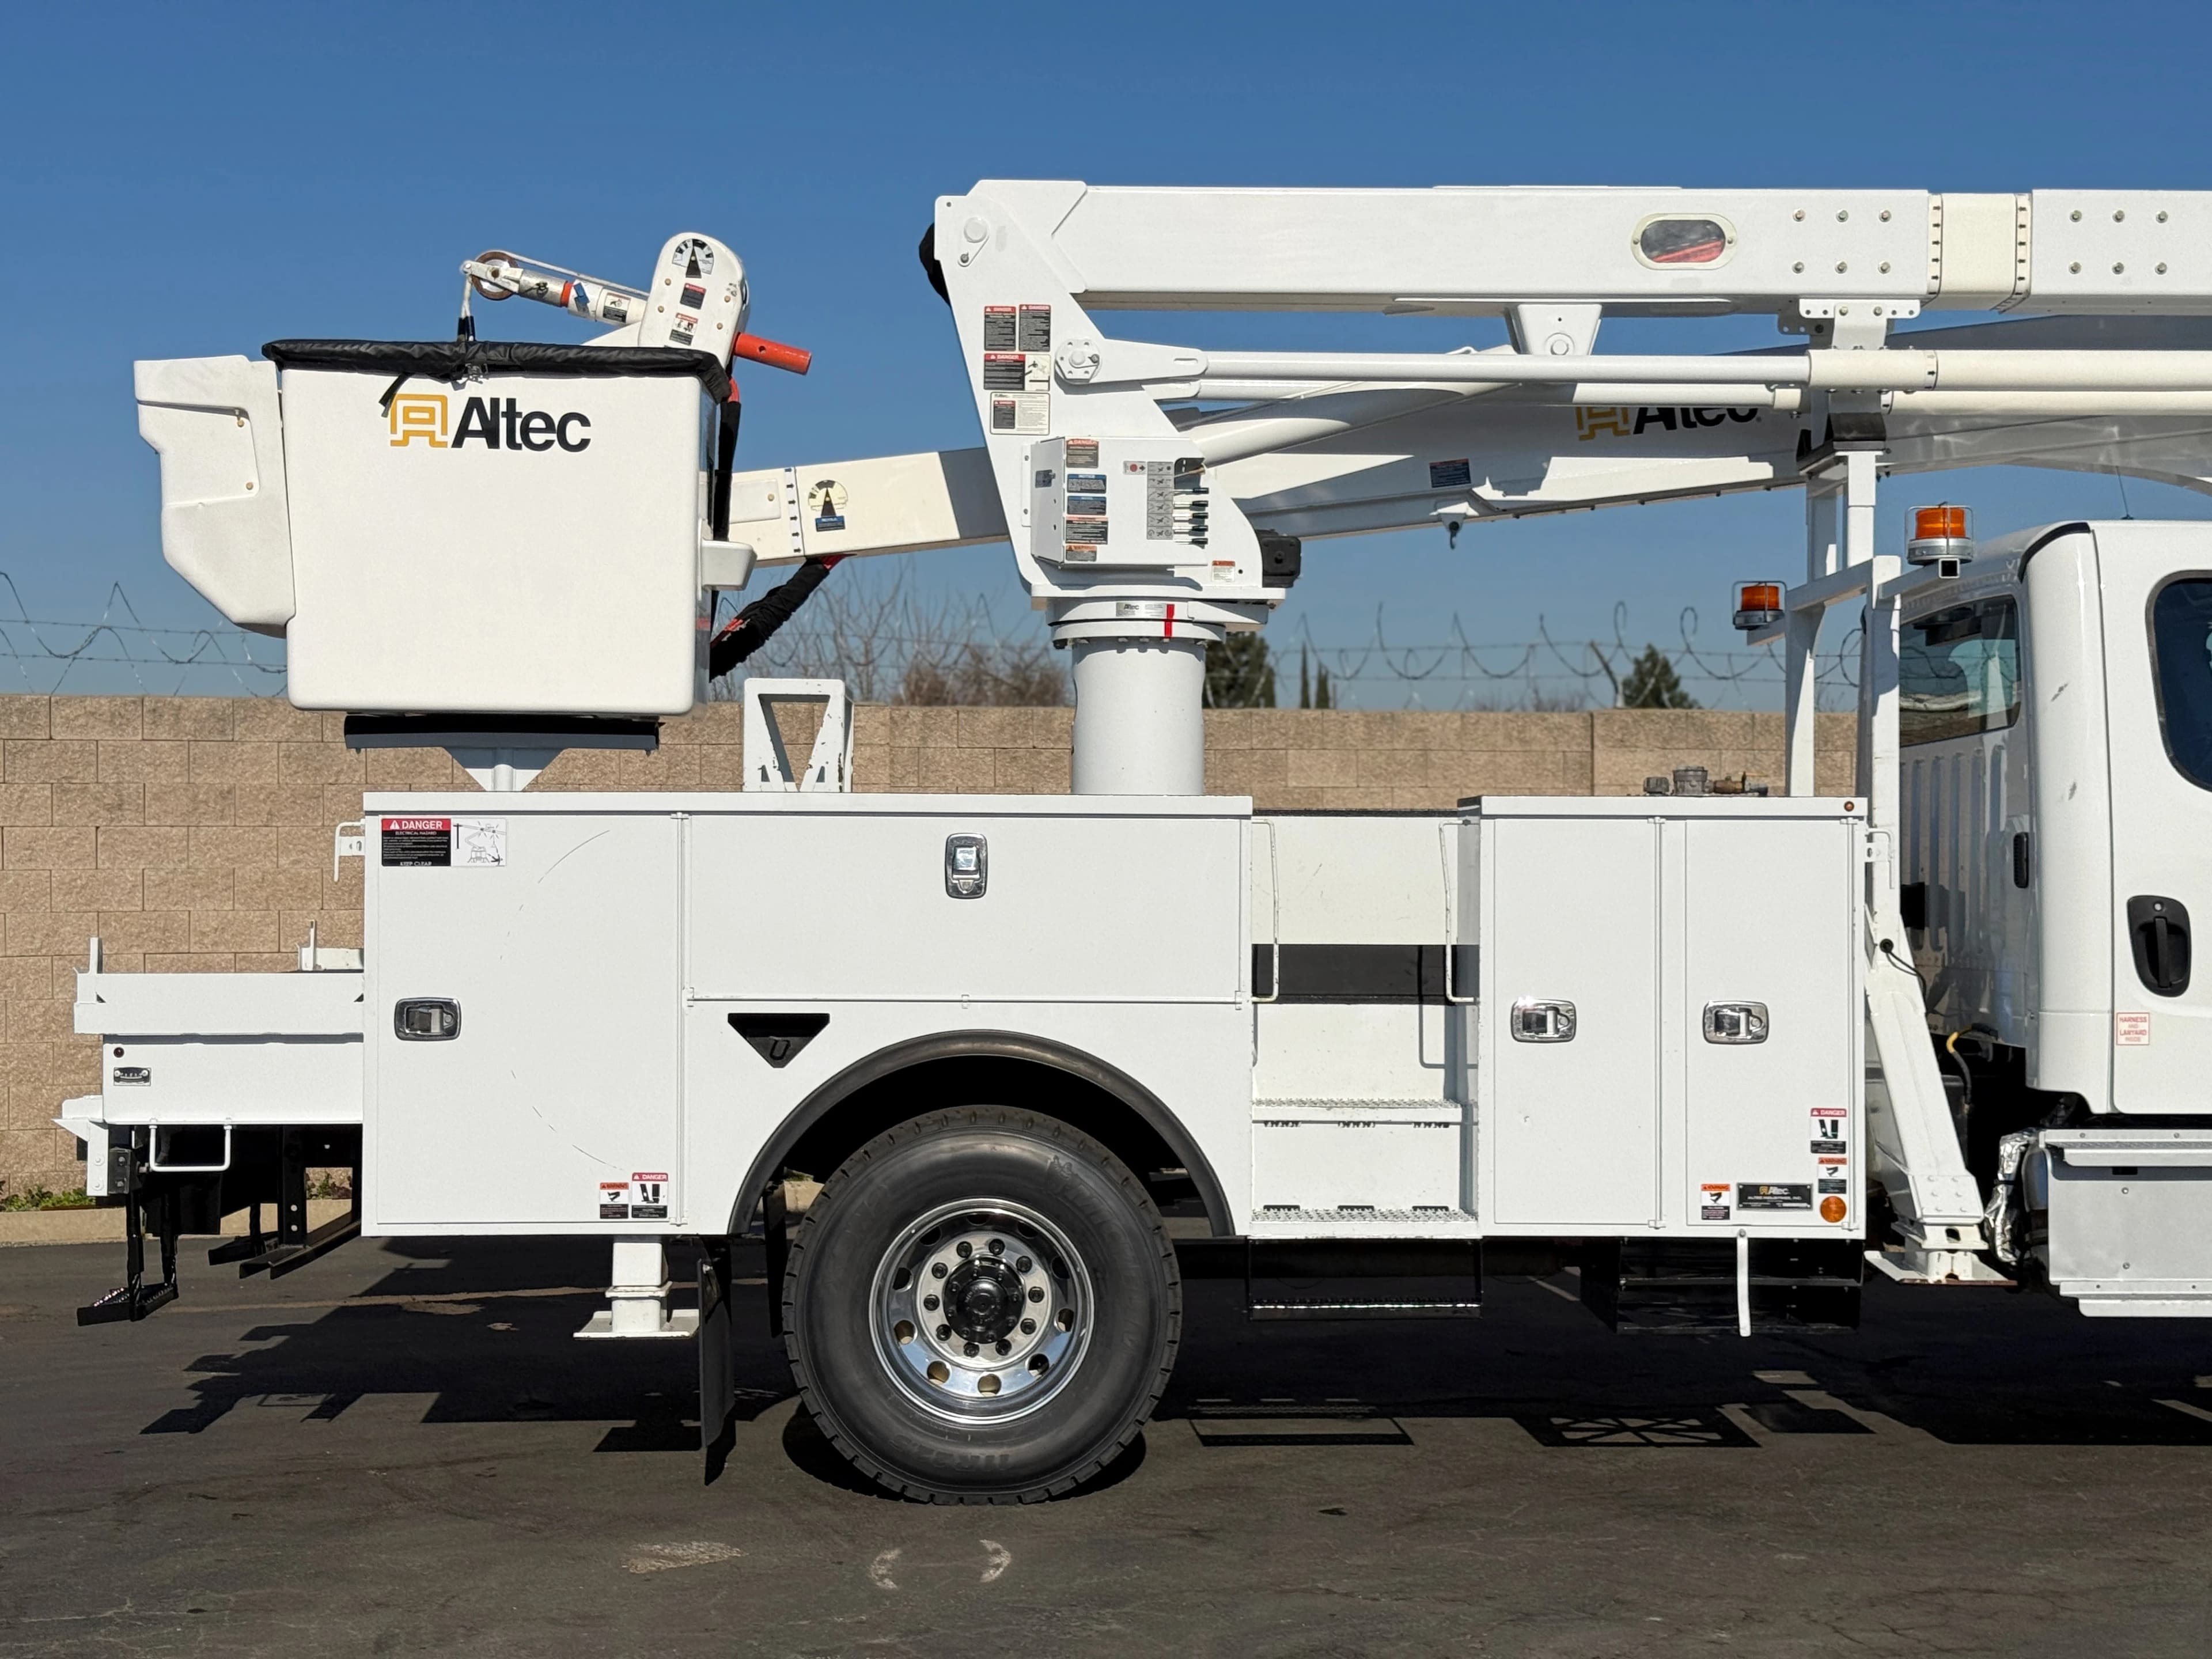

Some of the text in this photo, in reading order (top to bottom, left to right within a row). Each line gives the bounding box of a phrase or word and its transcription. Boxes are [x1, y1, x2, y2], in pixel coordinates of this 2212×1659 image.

[451, 397, 592, 452] Altec
[402, 821, 443, 830] DANGER
[1768, 1186, 1790, 1195] Altec
